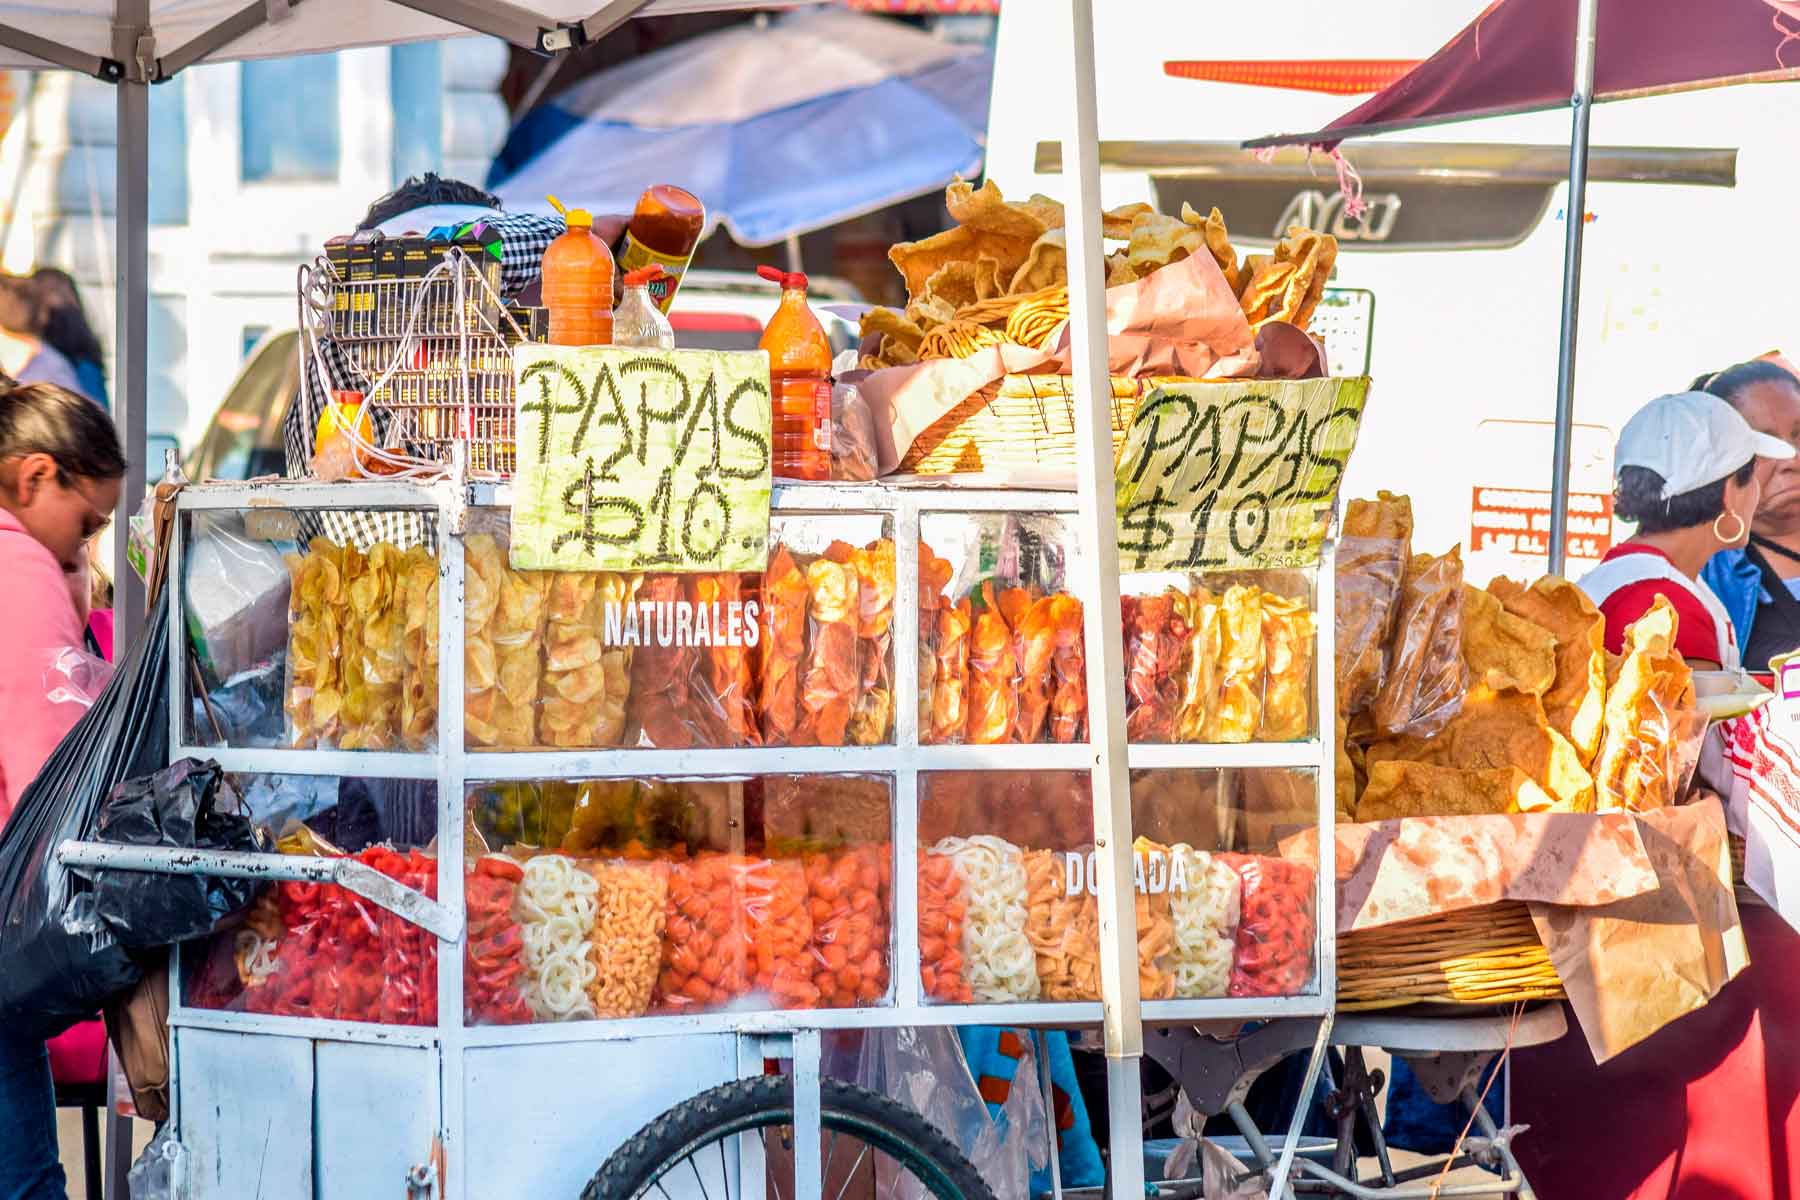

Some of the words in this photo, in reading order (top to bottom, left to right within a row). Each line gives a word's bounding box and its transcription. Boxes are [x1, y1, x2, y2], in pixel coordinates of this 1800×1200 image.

[519, 357, 769, 481] PAPAS
[1134, 394, 1360, 501] PAPAS
[604, 600, 760, 648] NATURALES
[1065, 851, 1188, 897] DOADA
